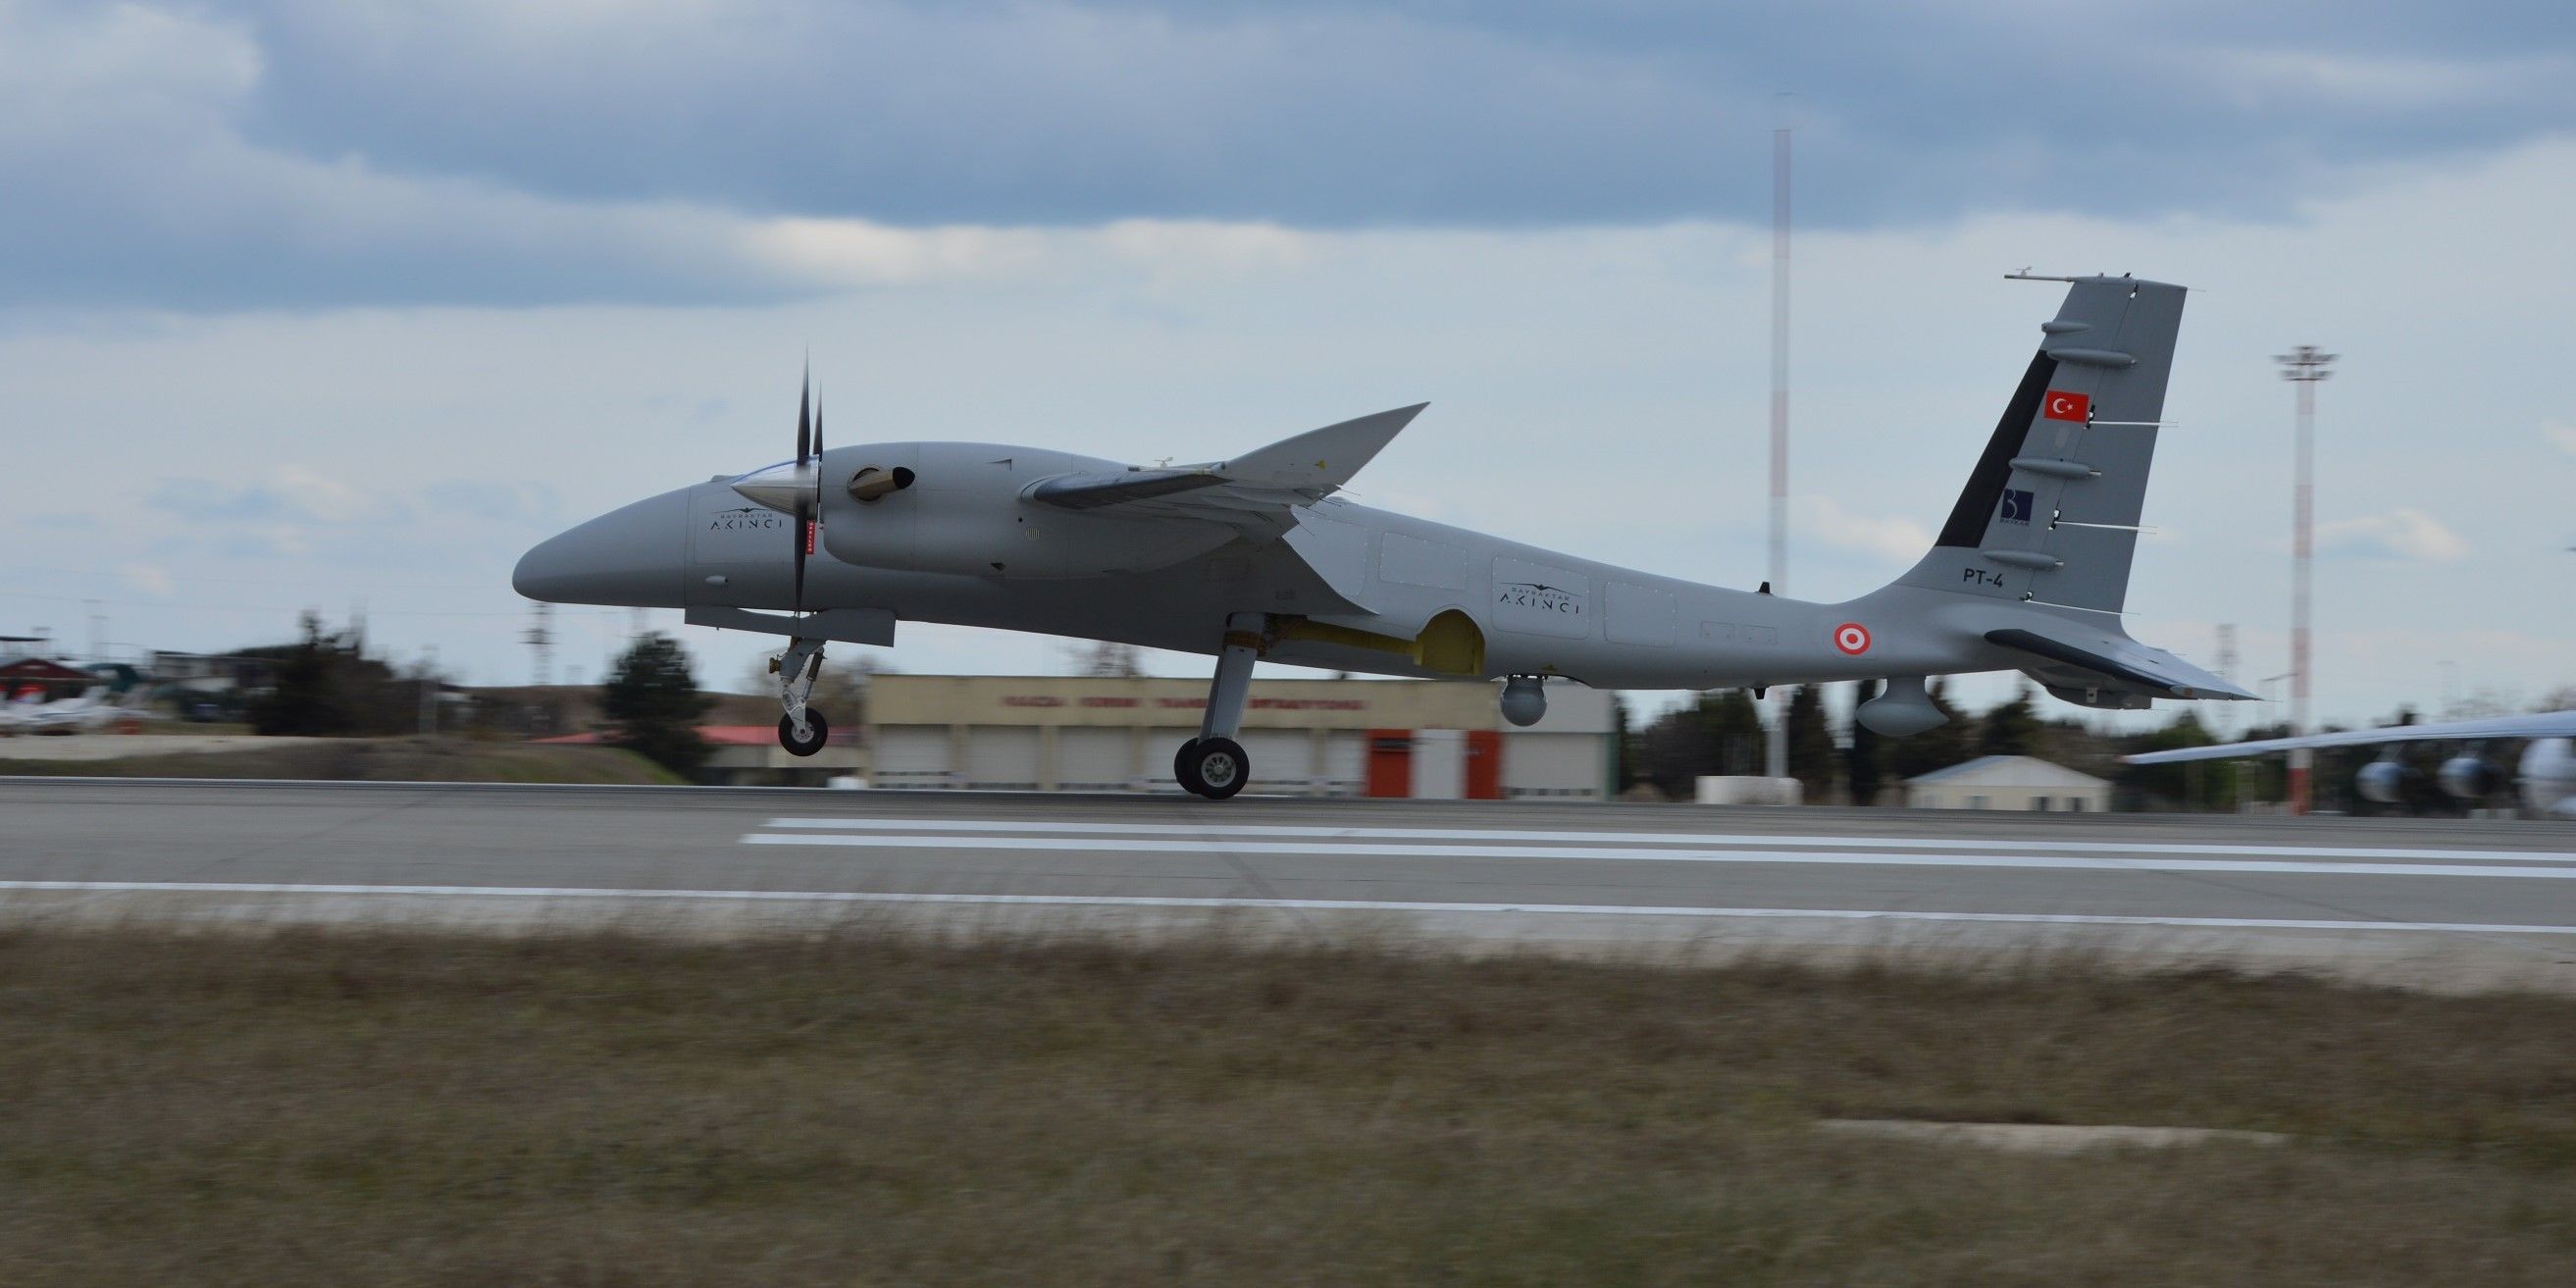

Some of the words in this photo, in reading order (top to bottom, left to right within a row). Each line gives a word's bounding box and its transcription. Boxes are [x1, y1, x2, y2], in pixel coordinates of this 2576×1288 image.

[710, 520, 782, 530] AKINCI
[1963, 569, 2003, 588] PT-4
[1501, 593, 1578, 614] AKINCI
